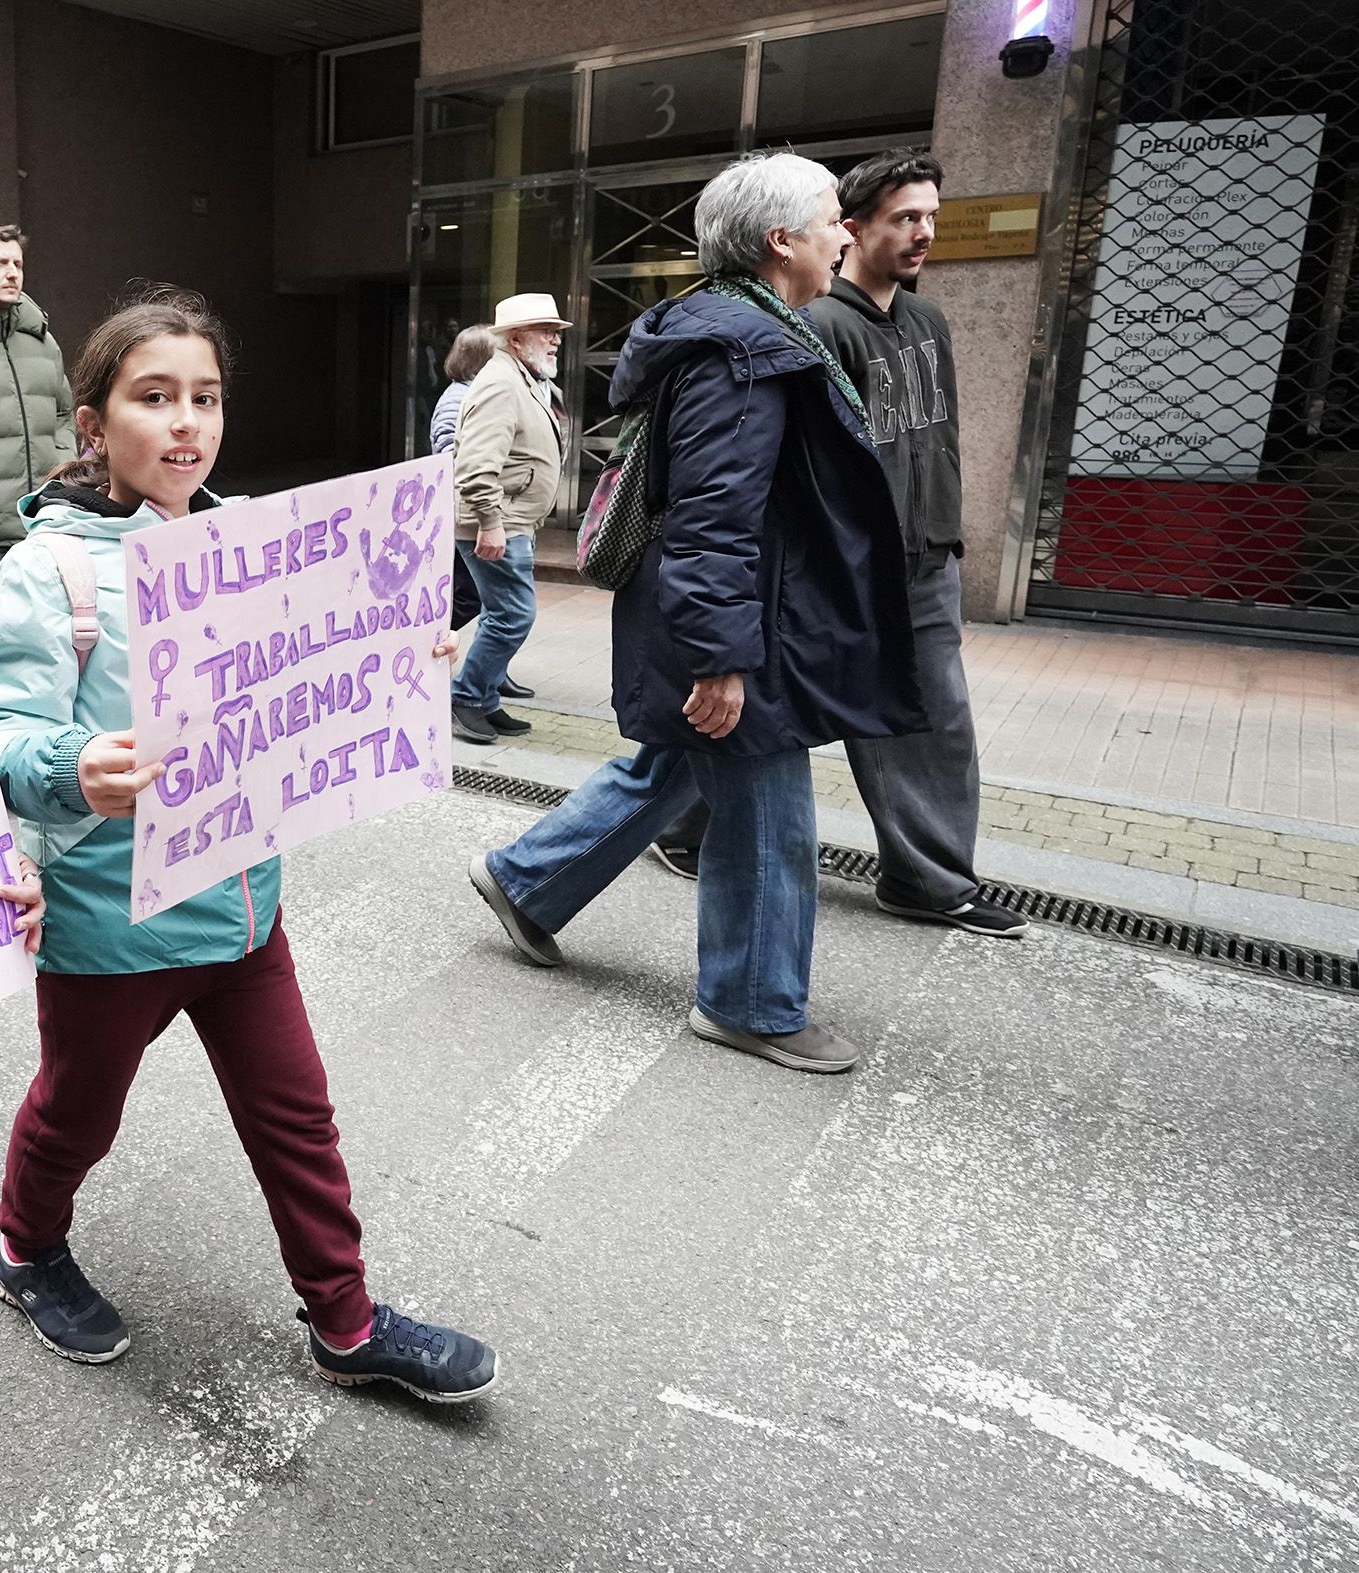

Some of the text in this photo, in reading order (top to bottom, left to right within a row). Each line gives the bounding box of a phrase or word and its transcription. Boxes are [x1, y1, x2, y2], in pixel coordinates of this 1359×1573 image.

[645, 84, 676, 138] 3
[1139, 129, 1270, 155] PELUQUERÍA
[1142, 161, 1188, 172] Peinar
[1114, 305, 1207, 324] ESTÉTICA
[1183, 332, 1190, 343] y
[1108, 394, 1195, 404] Tatamientos
[1119, 432, 1150, 445] Cita
[136, 506, 352, 626] MULLERES
[194, 574, 450, 701] TRABALLADORAS
[154, 652, 381, 808] GAÑAREMOS
[164, 726, 420, 867] ESTA LOITA
